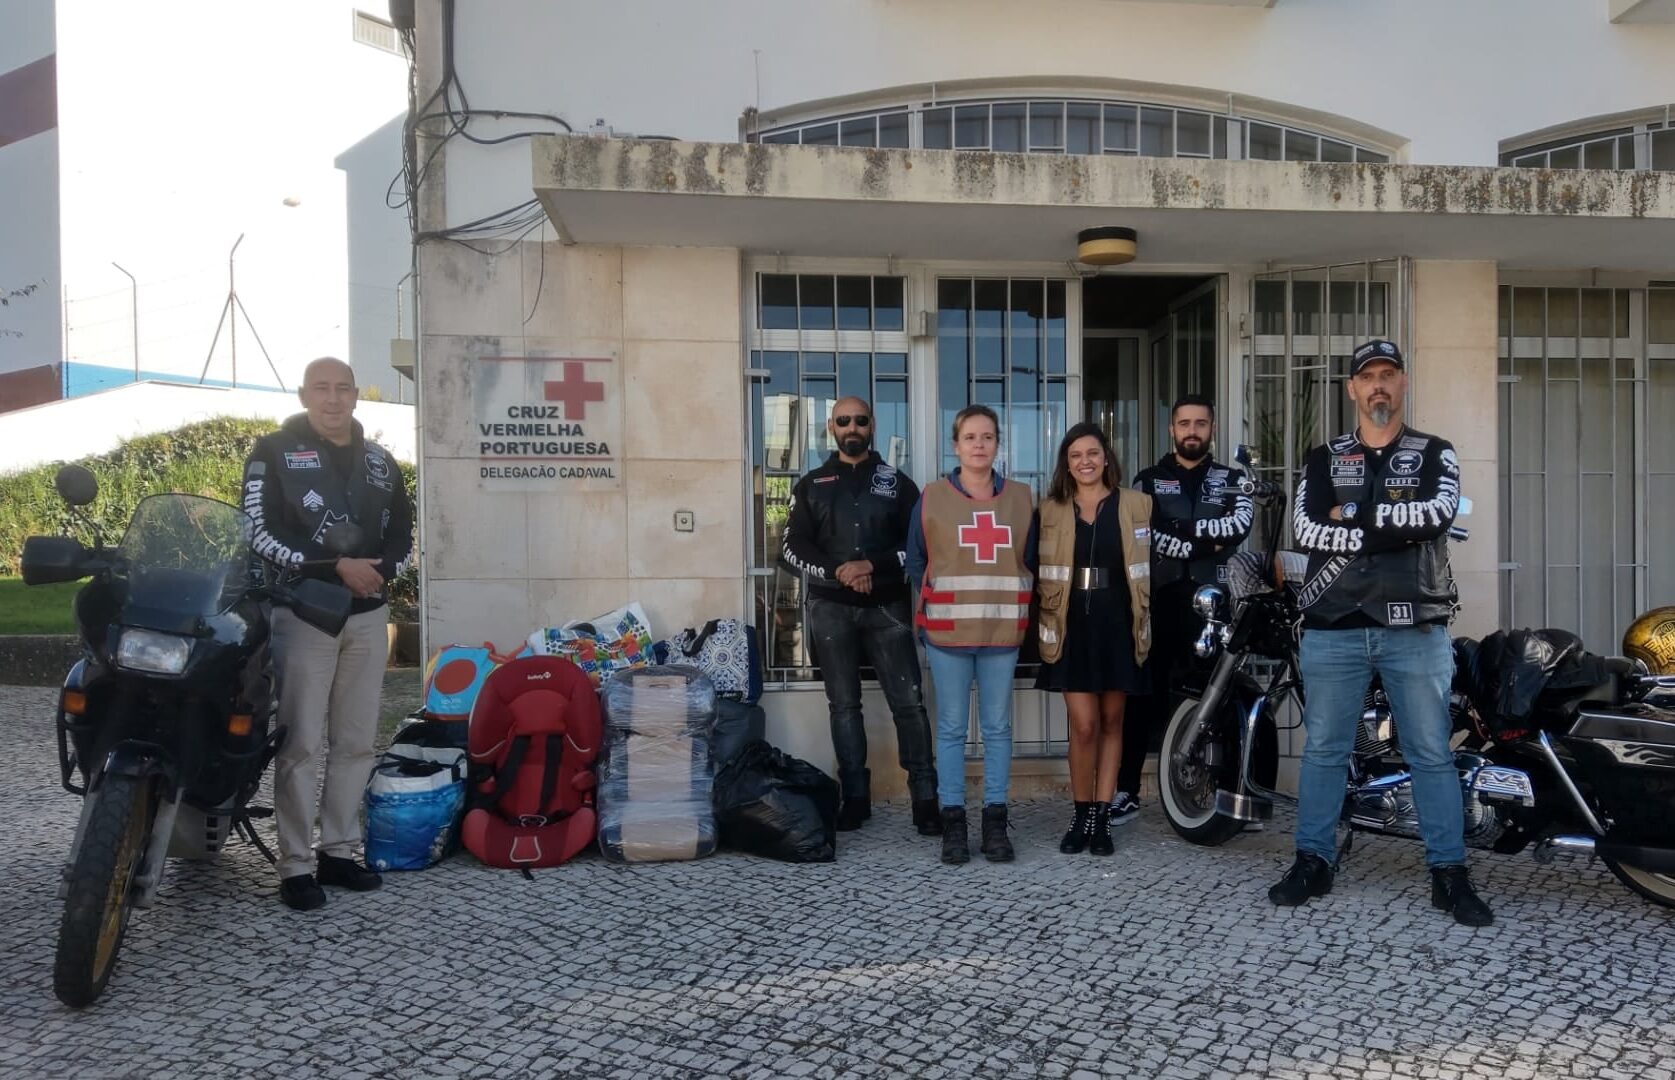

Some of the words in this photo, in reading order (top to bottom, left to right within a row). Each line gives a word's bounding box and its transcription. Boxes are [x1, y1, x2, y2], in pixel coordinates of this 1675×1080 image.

[507, 406, 559, 419] CRUZ
[479, 423, 584, 437] VERMELHA
[480, 442, 610, 455] PORTUGUESA
[559, 467, 615, 478] CADAVAL
[1392, 605, 1408, 618] 31
